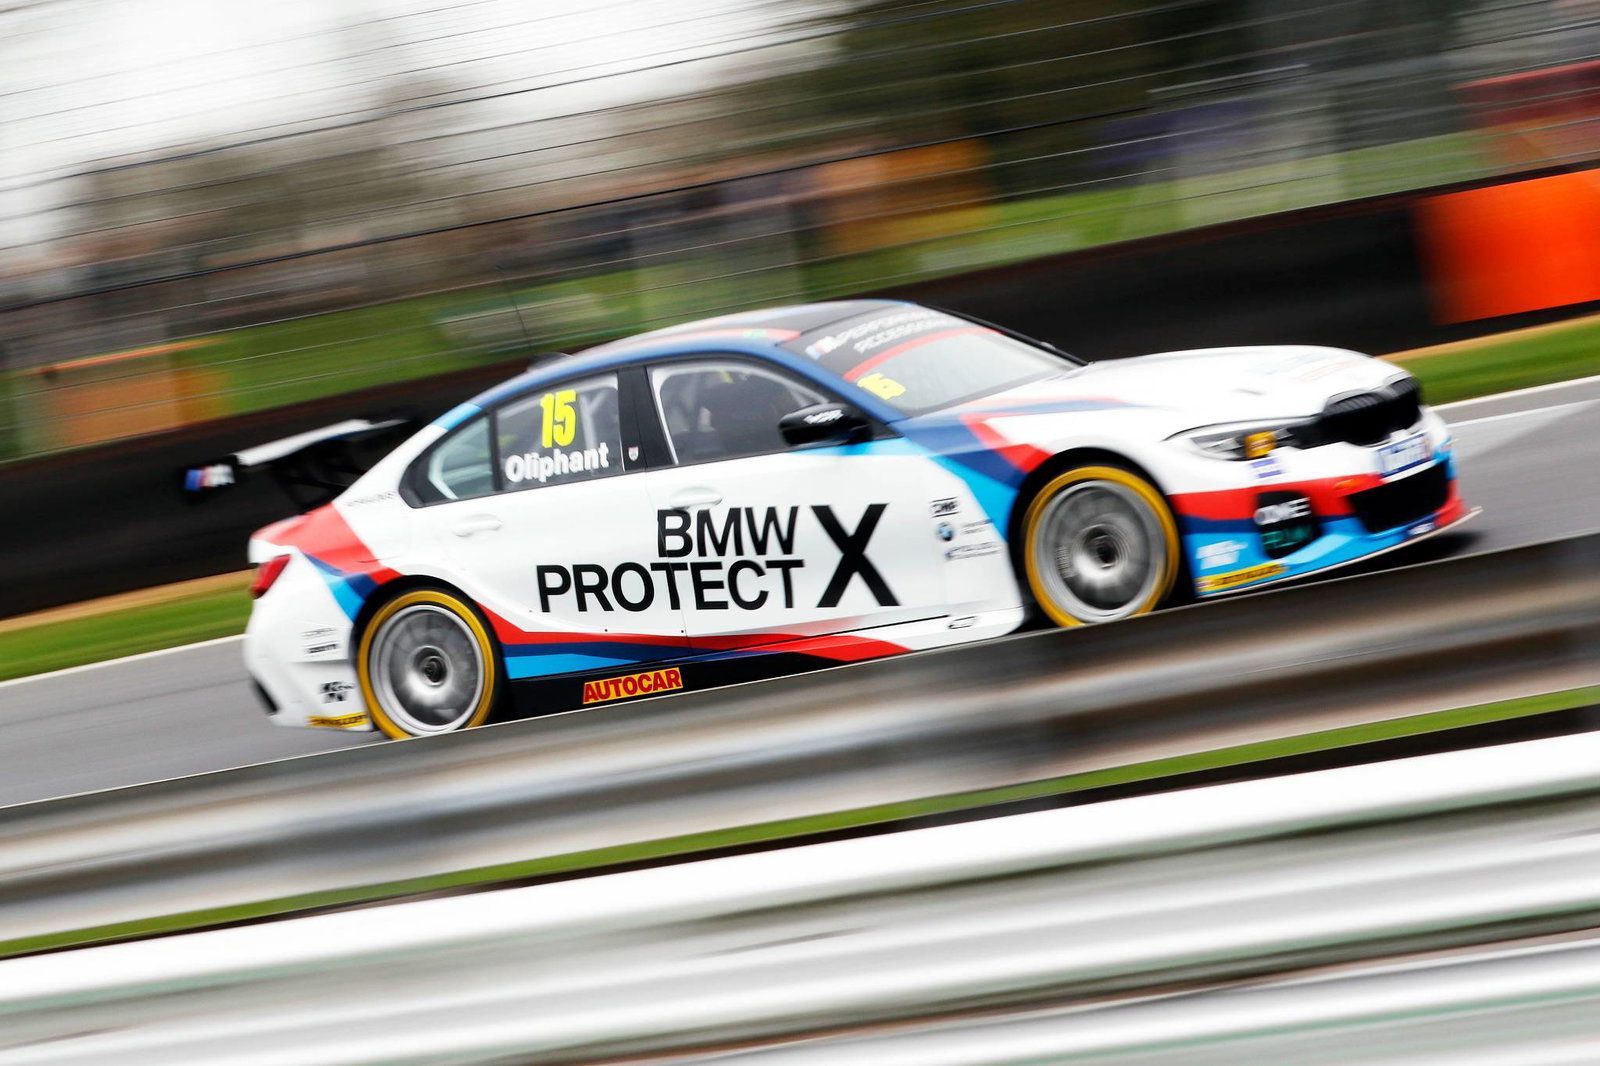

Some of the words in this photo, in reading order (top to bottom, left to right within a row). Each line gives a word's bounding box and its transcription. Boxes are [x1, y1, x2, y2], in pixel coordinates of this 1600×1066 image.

[540, 389, 577, 448] 15
[505, 442, 609, 483] Oliphant
[657, 505, 799, 558] BMW
[810, 503, 902, 608] X
[536, 559, 805, 613] PROTECT
[583, 669, 682, 703] AUTOCAR
